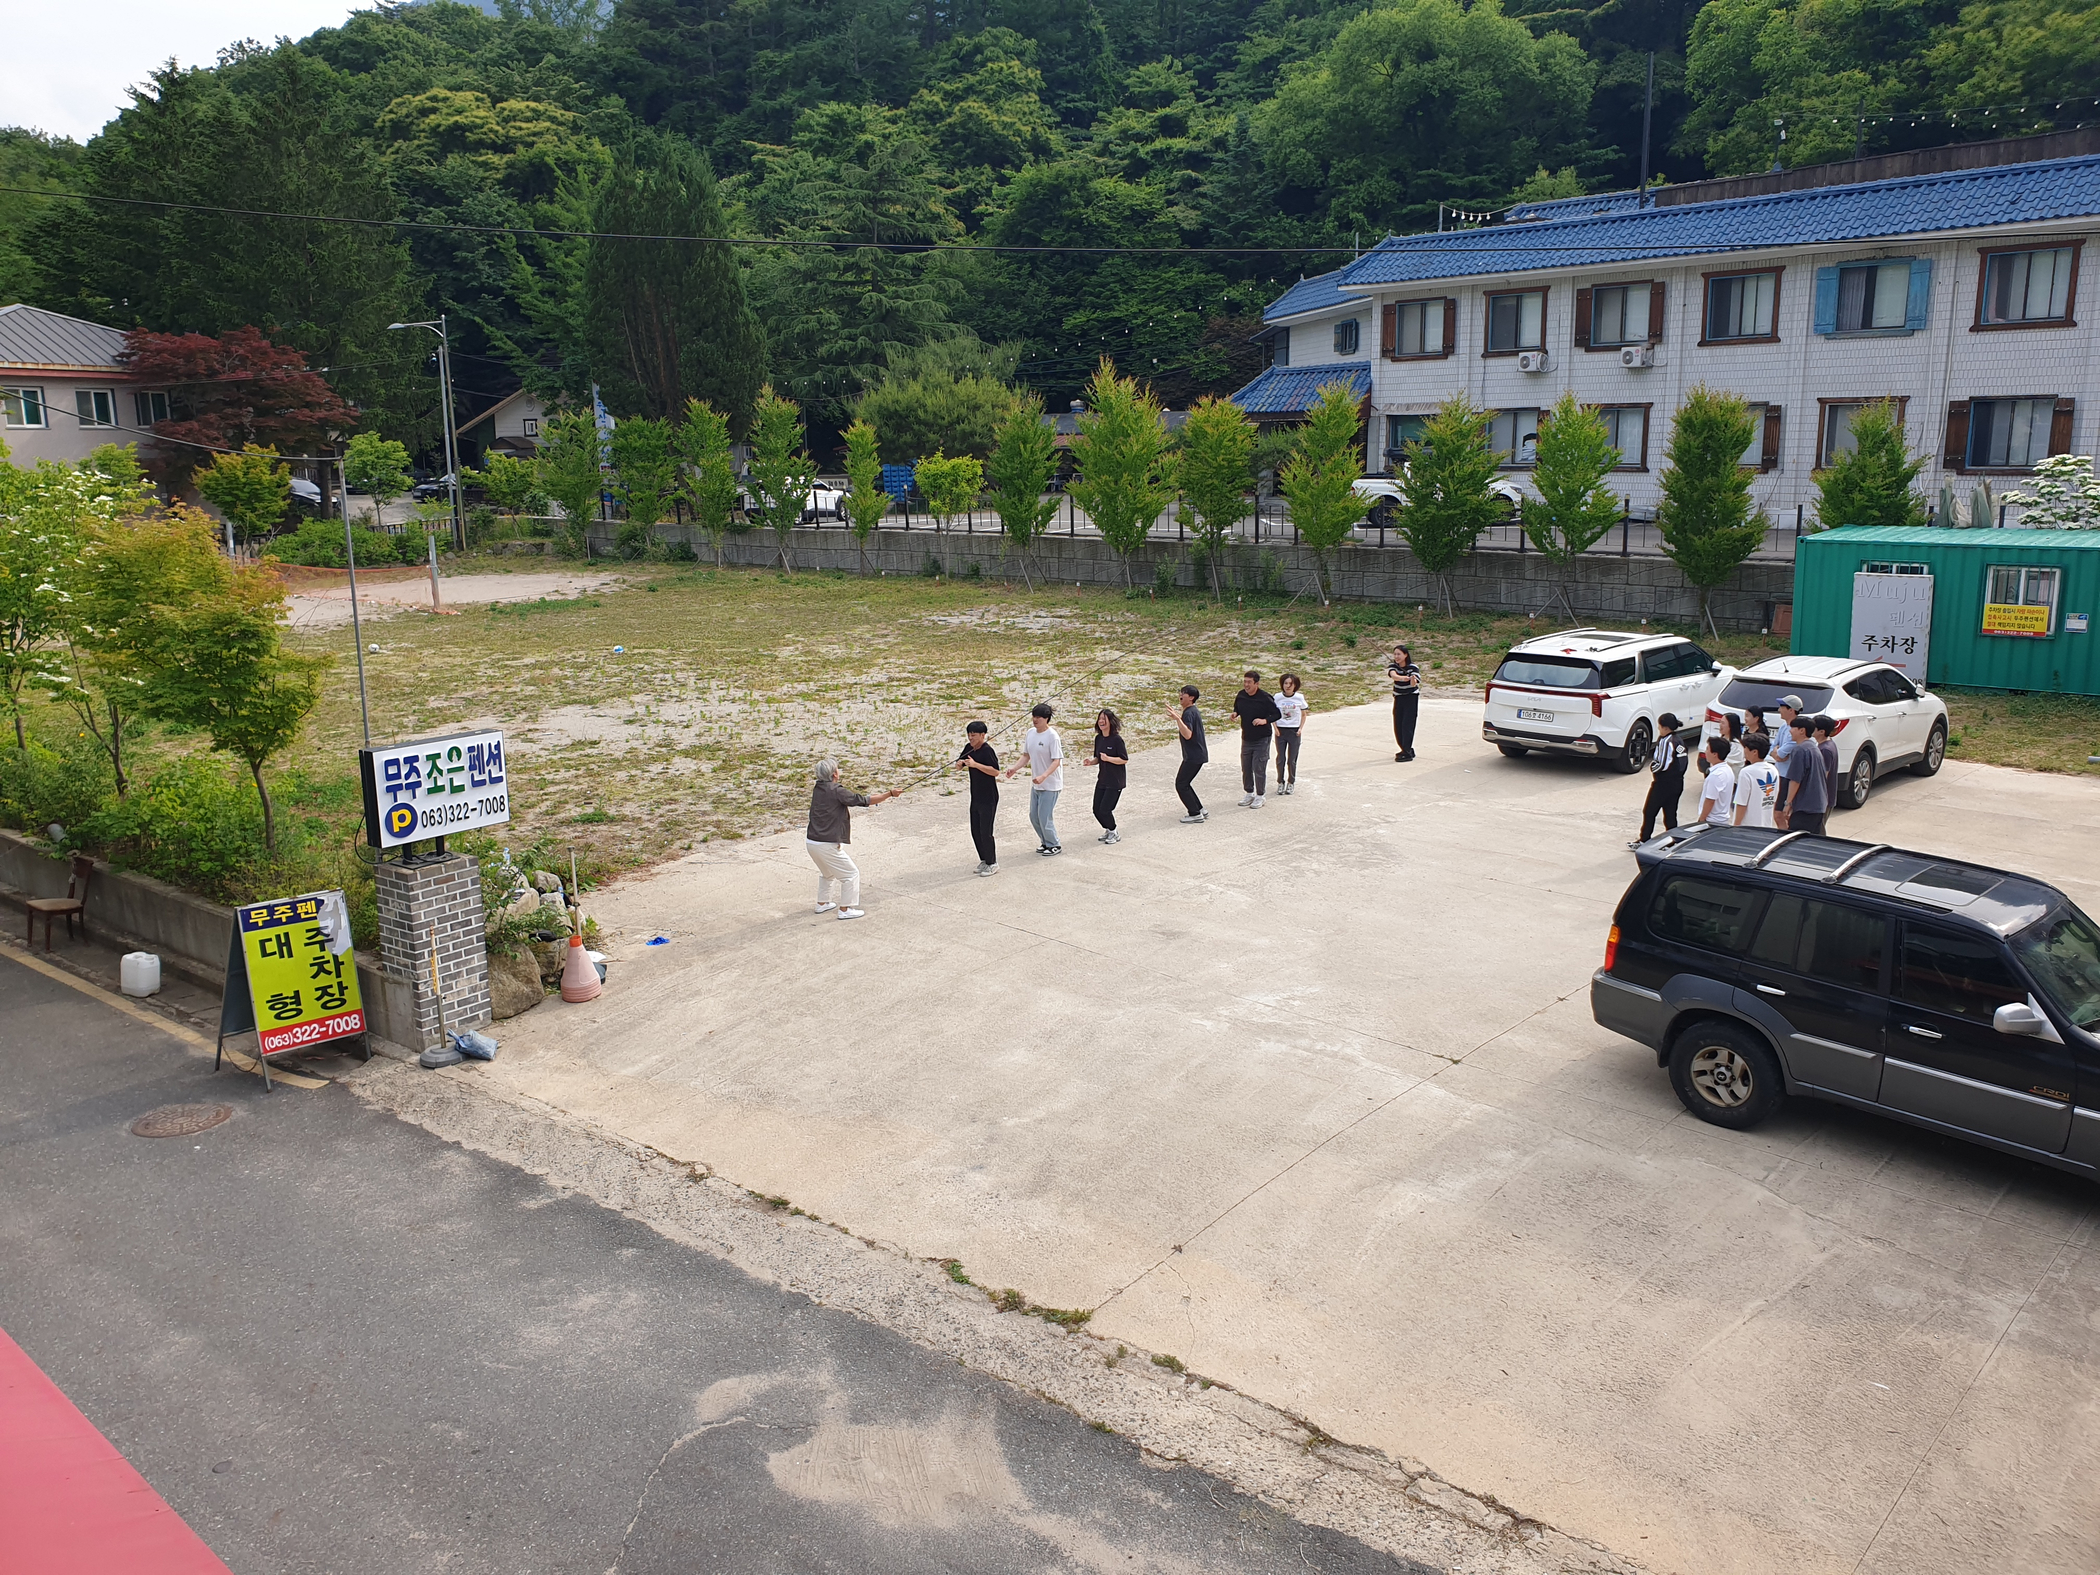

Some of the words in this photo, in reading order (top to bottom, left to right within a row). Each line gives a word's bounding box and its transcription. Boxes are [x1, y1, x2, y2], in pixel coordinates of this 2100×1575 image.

[1855, 579, 1926, 604] Muju
[1861, 634, 1918, 655] 주차장
[384, 754, 423, 803] 무주
[425, 746, 466, 795] 조은
[467, 740, 504, 788] 펜션
[421, 795, 506, 828] 063)322-7008
[264, 1013, 361, 1051] (063)322-7008
